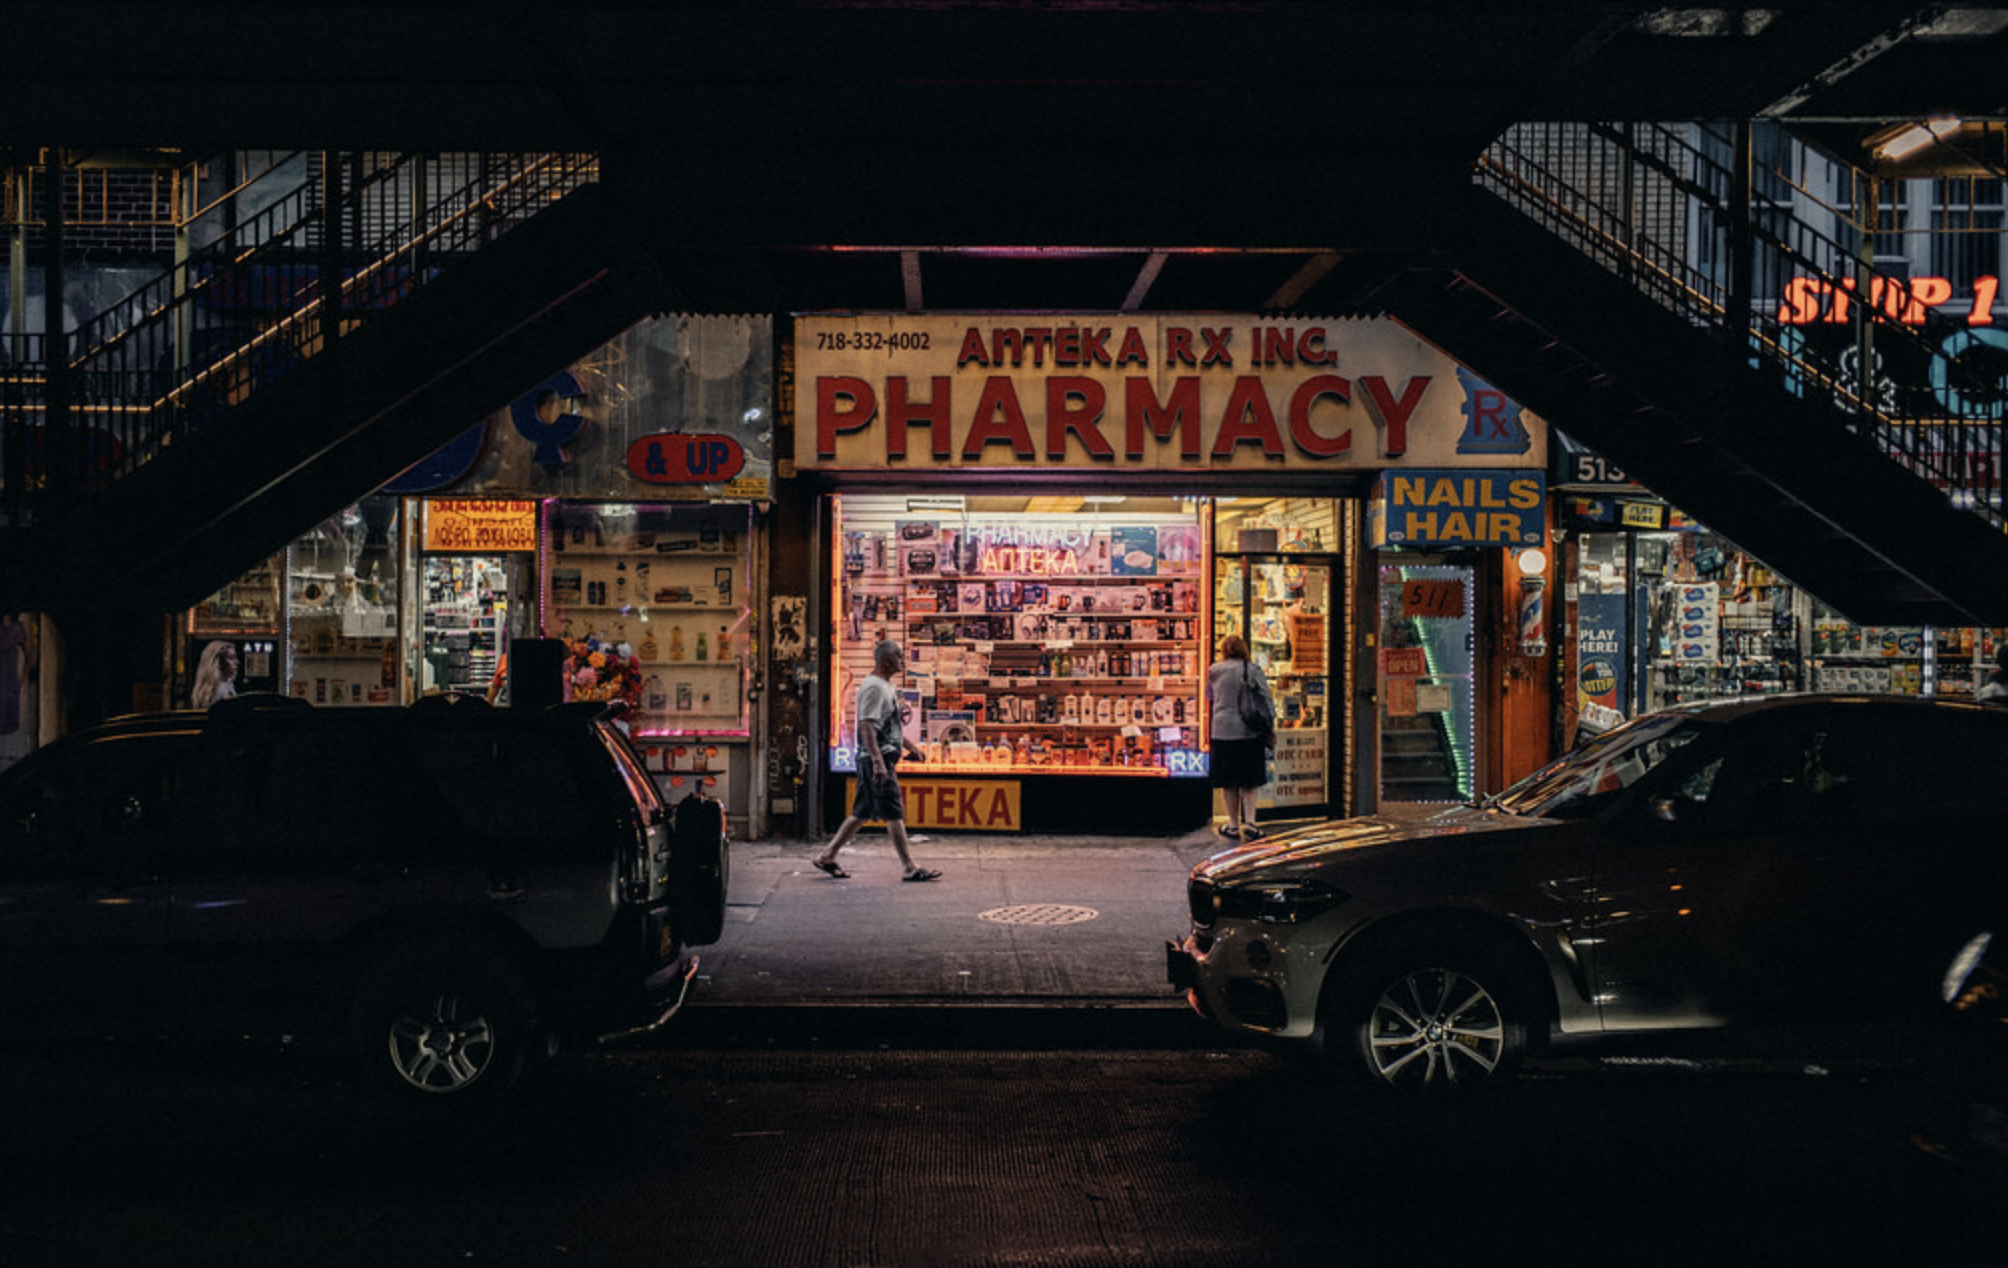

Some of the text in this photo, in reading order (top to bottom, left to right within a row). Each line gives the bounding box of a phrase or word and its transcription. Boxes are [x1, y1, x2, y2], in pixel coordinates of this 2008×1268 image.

[1967, 275, 1998, 325] 1
[817, 332, 930, 351] 718-332-4002
[1165, 327, 1233, 366] RX
[1250, 327, 1338, 367] INC.
[816, 375, 1432, 459] PHARMACY
[645, 442, 730, 475] & UP
[1393, 477, 1541, 508] NAILS
[966, 525, 1094, 547] PHARMACY
[1406, 512, 1522, 542] HAIR
[1409, 585, 1448, 610] 511
[1579, 641, 1618, 653] HERE!
[1580, 629, 1616, 640] PLAY
[1388, 659, 1418, 672] OPEN
[1171, 752, 1204, 771] RX
